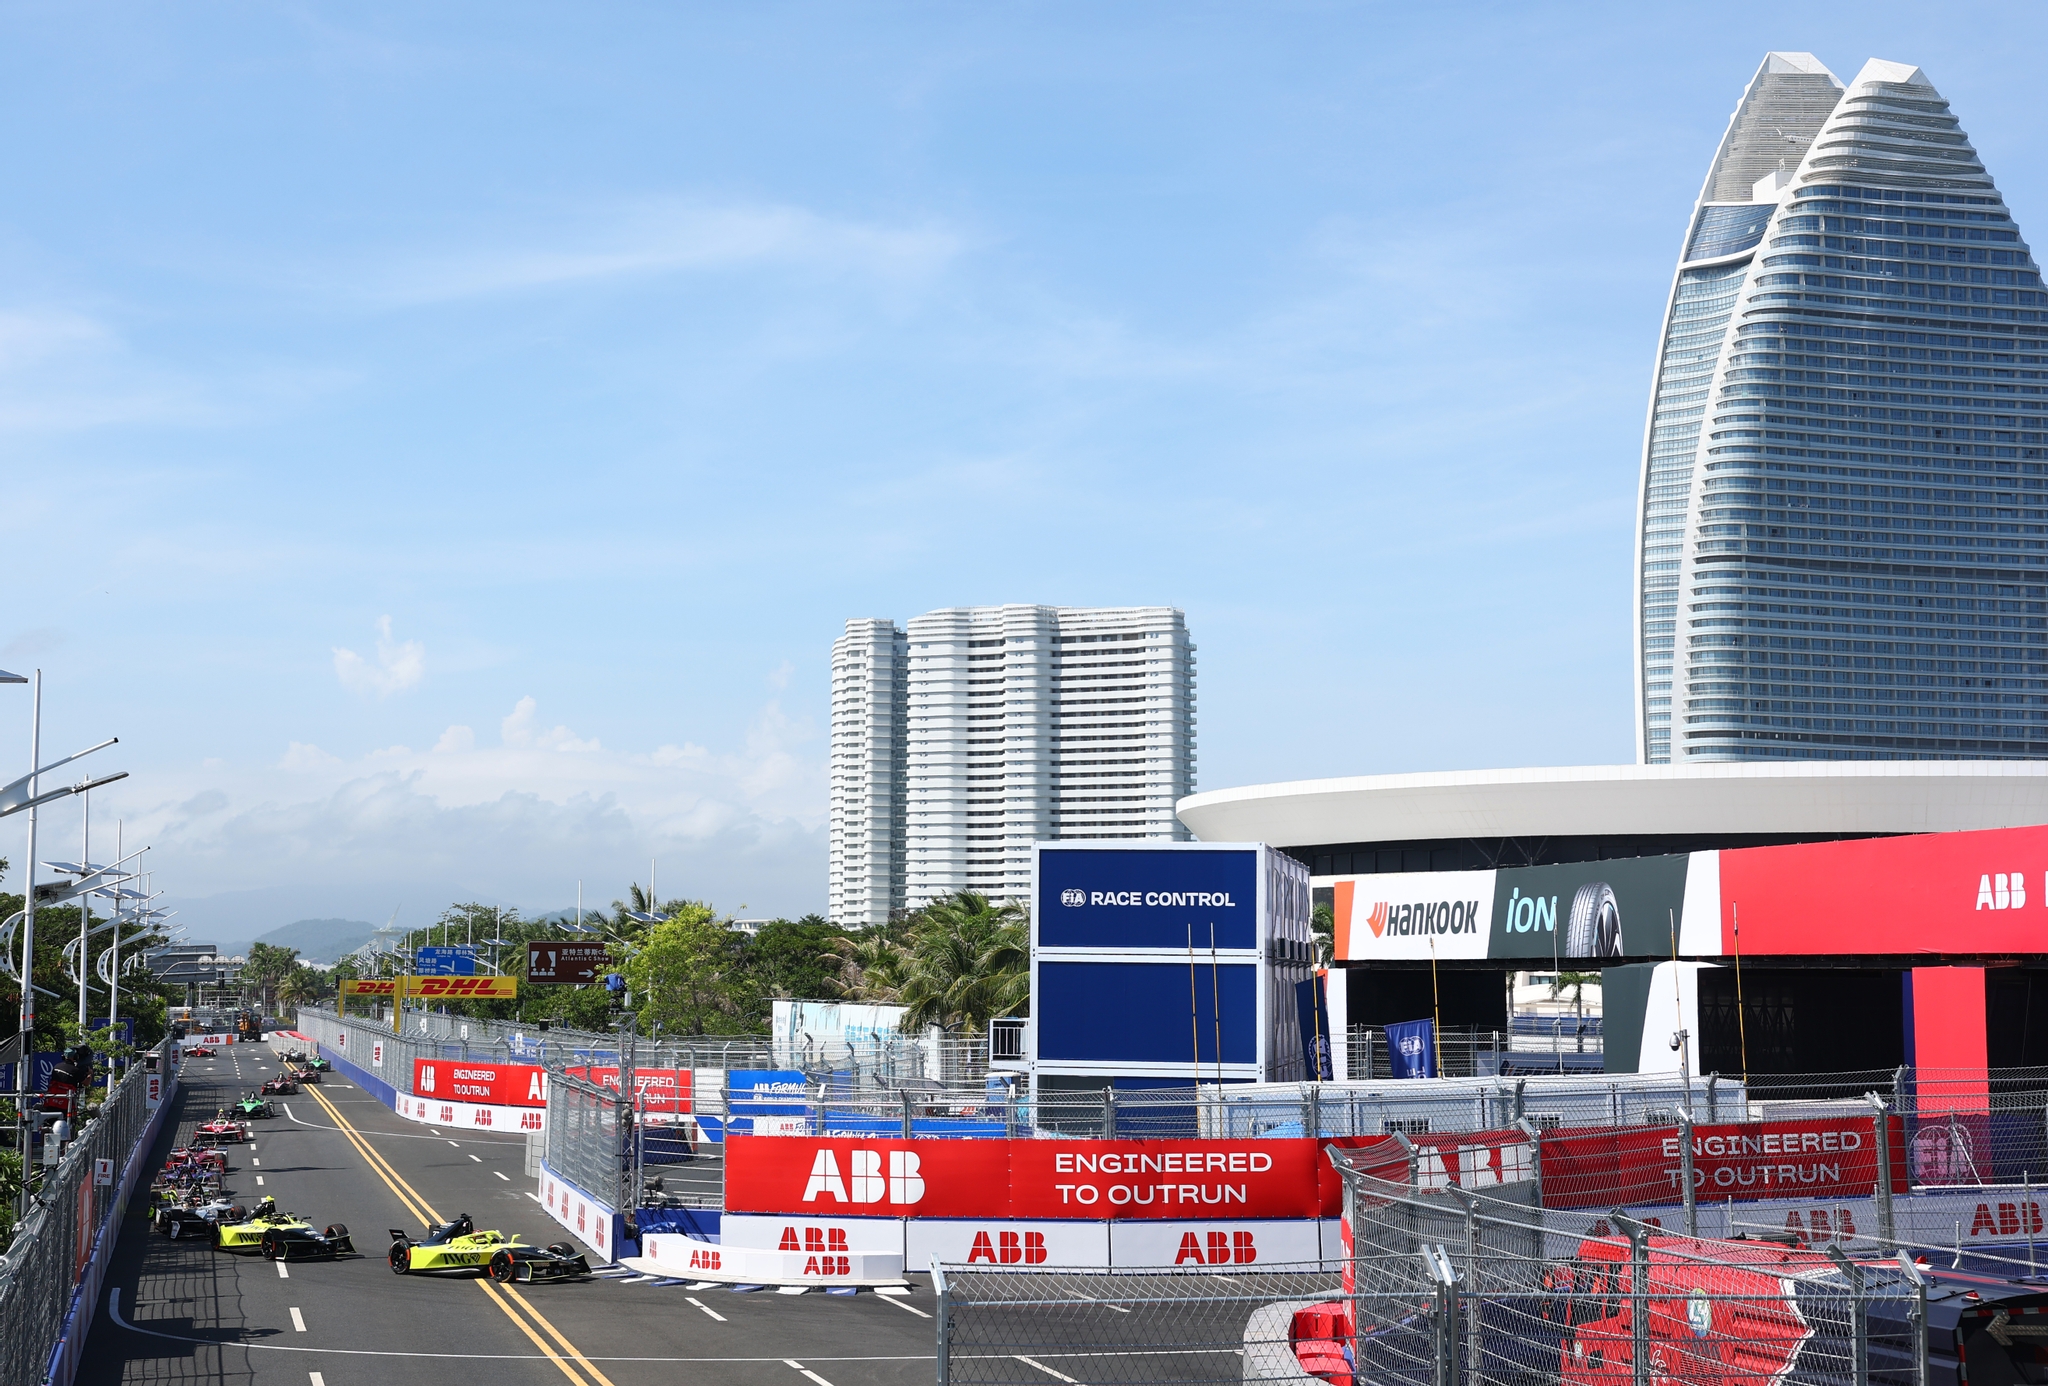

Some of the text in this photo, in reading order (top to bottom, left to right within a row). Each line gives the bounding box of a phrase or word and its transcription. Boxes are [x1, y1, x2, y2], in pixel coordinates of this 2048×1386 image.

[1090, 891, 1142, 906] RACE
[1145, 891, 1235, 907] CONTROL
[1976, 872, 2026, 911] ABB
[356, 981, 396, 993] DH
[419, 979, 499, 995] DHL
[203, 1036, 220, 1044] ABB
[420, 1065, 436, 1092] ABB
[453, 1068, 496, 1083] ENGINEERED
[149, 1078, 160, 1101] ABB
[453, 1084, 490, 1097] TO OUTRUN
[440, 1105, 453, 1122] ABB
[474, 1109, 492, 1126] ABB
[520, 1112, 542, 1129] ABB
[1662, 1131, 1862, 1158] ENGINEERED
[1055, 1152, 1273, 1174] ENGINEERED
[801, 1148, 927, 1205] ABB
[1714, 1163, 1840, 1188] OUTRUN
[1055, 1184, 1247, 1205] TO OUTRUN
[1785, 1209, 1857, 1242] ABB
[1970, 1202, 2044, 1236] ABB
[967, 1230, 1048, 1264] ABB
[1174, 1231, 1257, 1265] ABB
[440, 1253, 471, 1265] TWG
[689, 1249, 722, 1270] ABB
[803, 1256, 851, 1275] ABB
